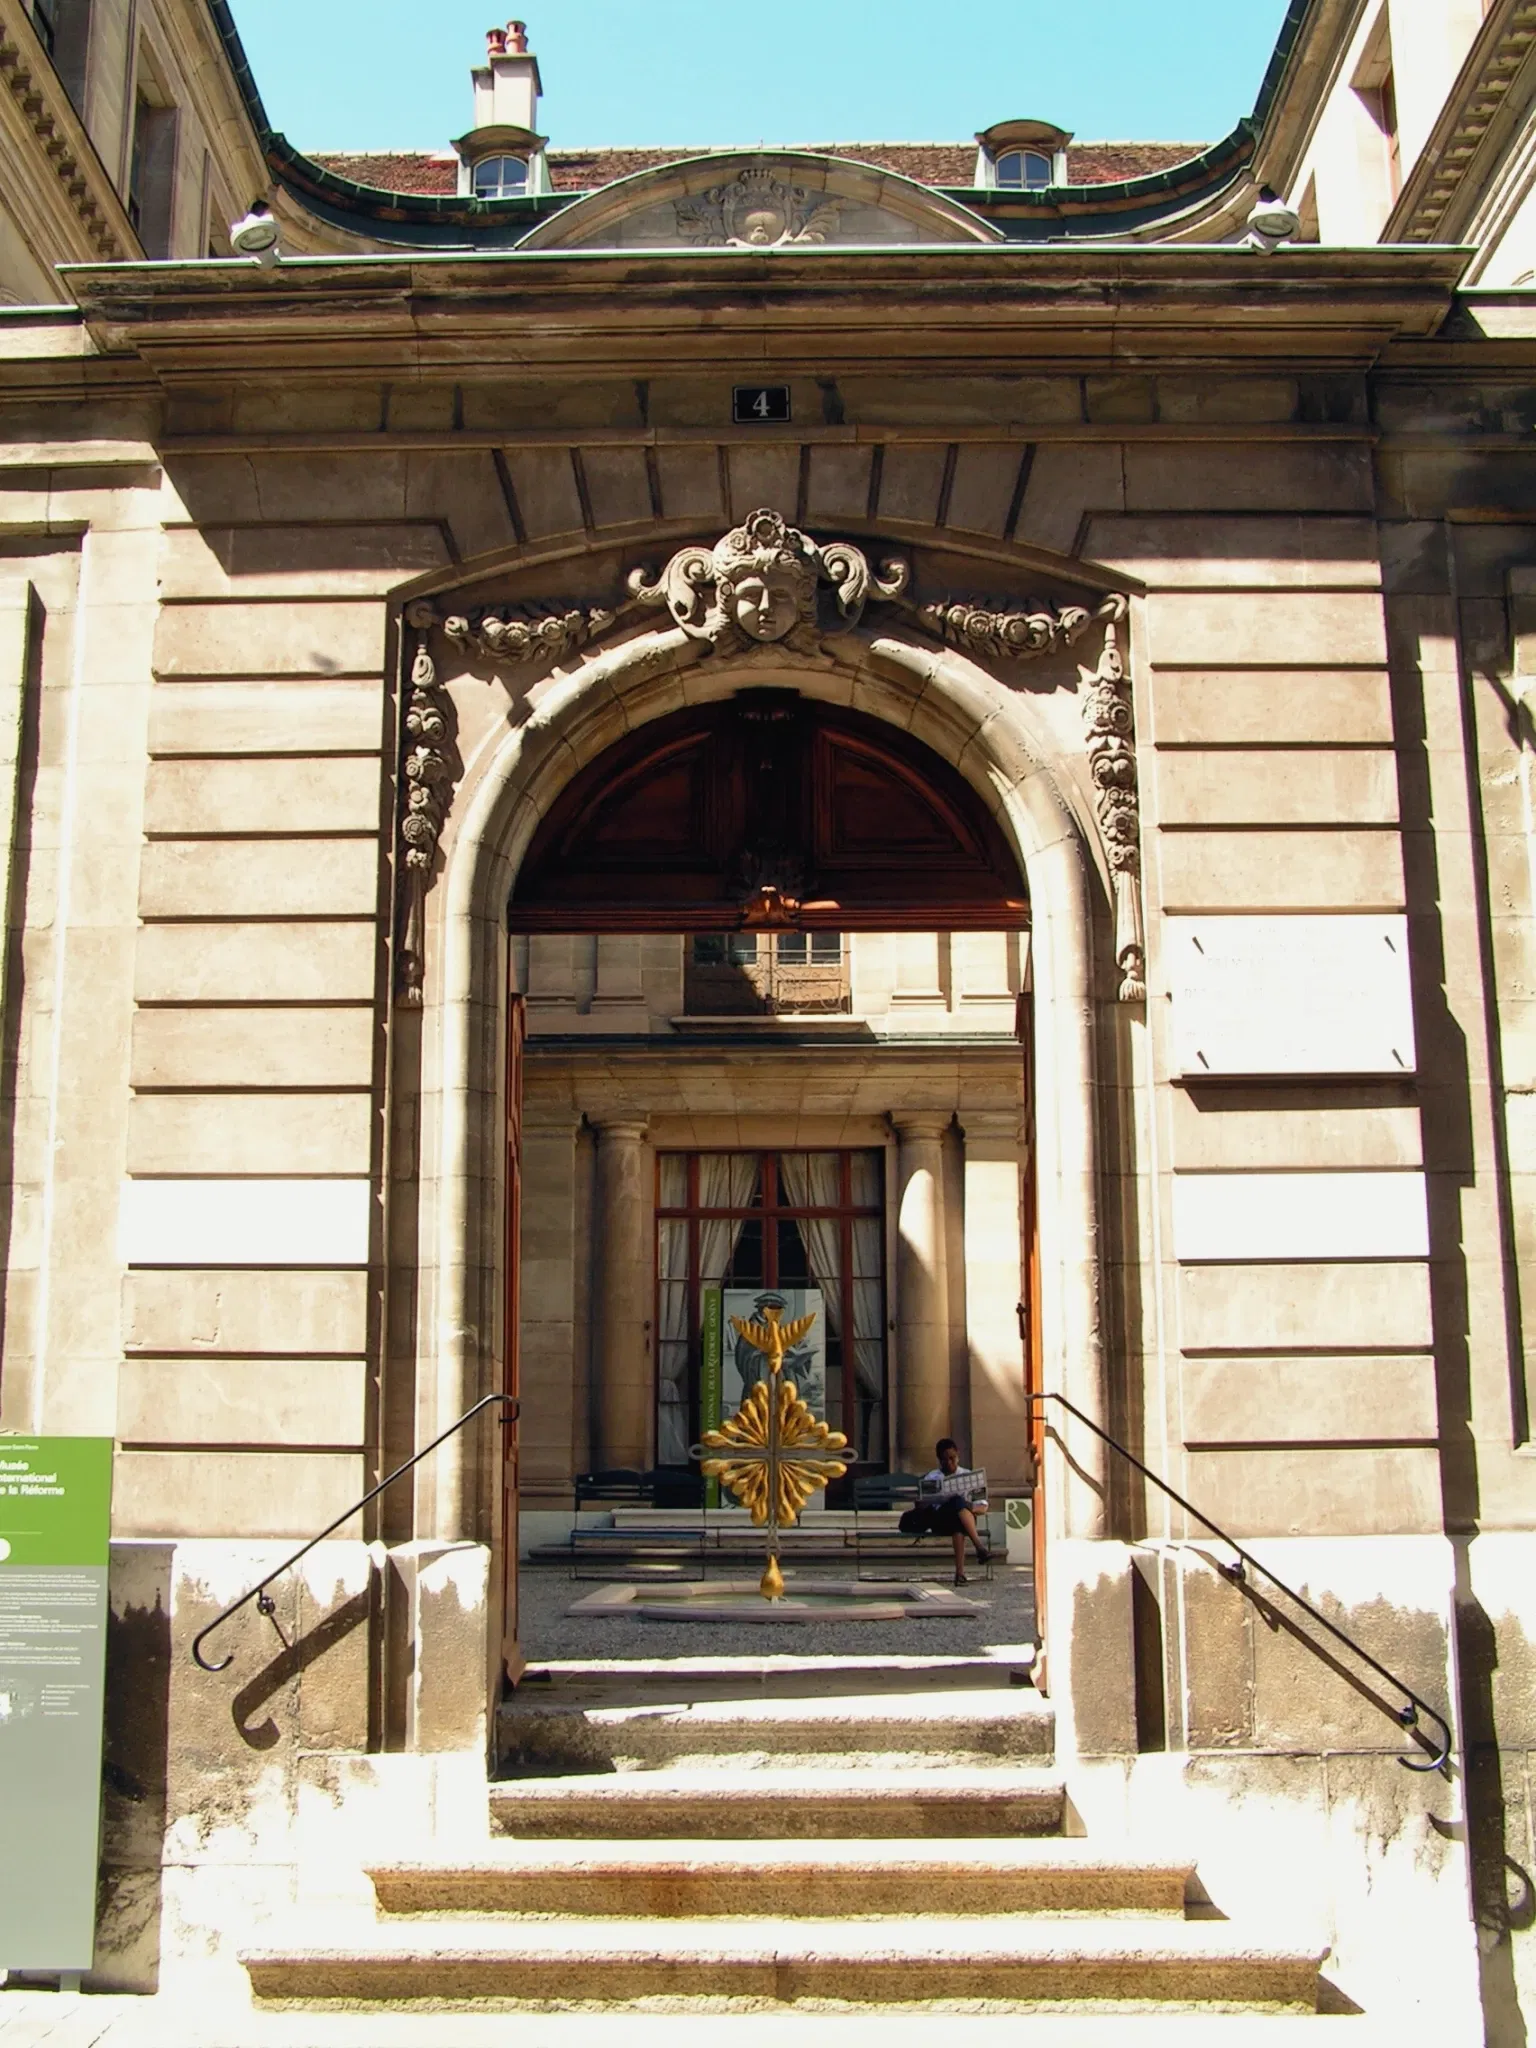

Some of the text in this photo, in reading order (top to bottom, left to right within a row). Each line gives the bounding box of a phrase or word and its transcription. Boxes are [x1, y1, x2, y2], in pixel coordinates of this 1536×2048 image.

[752, 391, 771, 417] 4
[0, 1471, 57, 1483] nternational
[8, 1484, 18, 1495] la
[20, 1484, 65, 1495] Réforme
